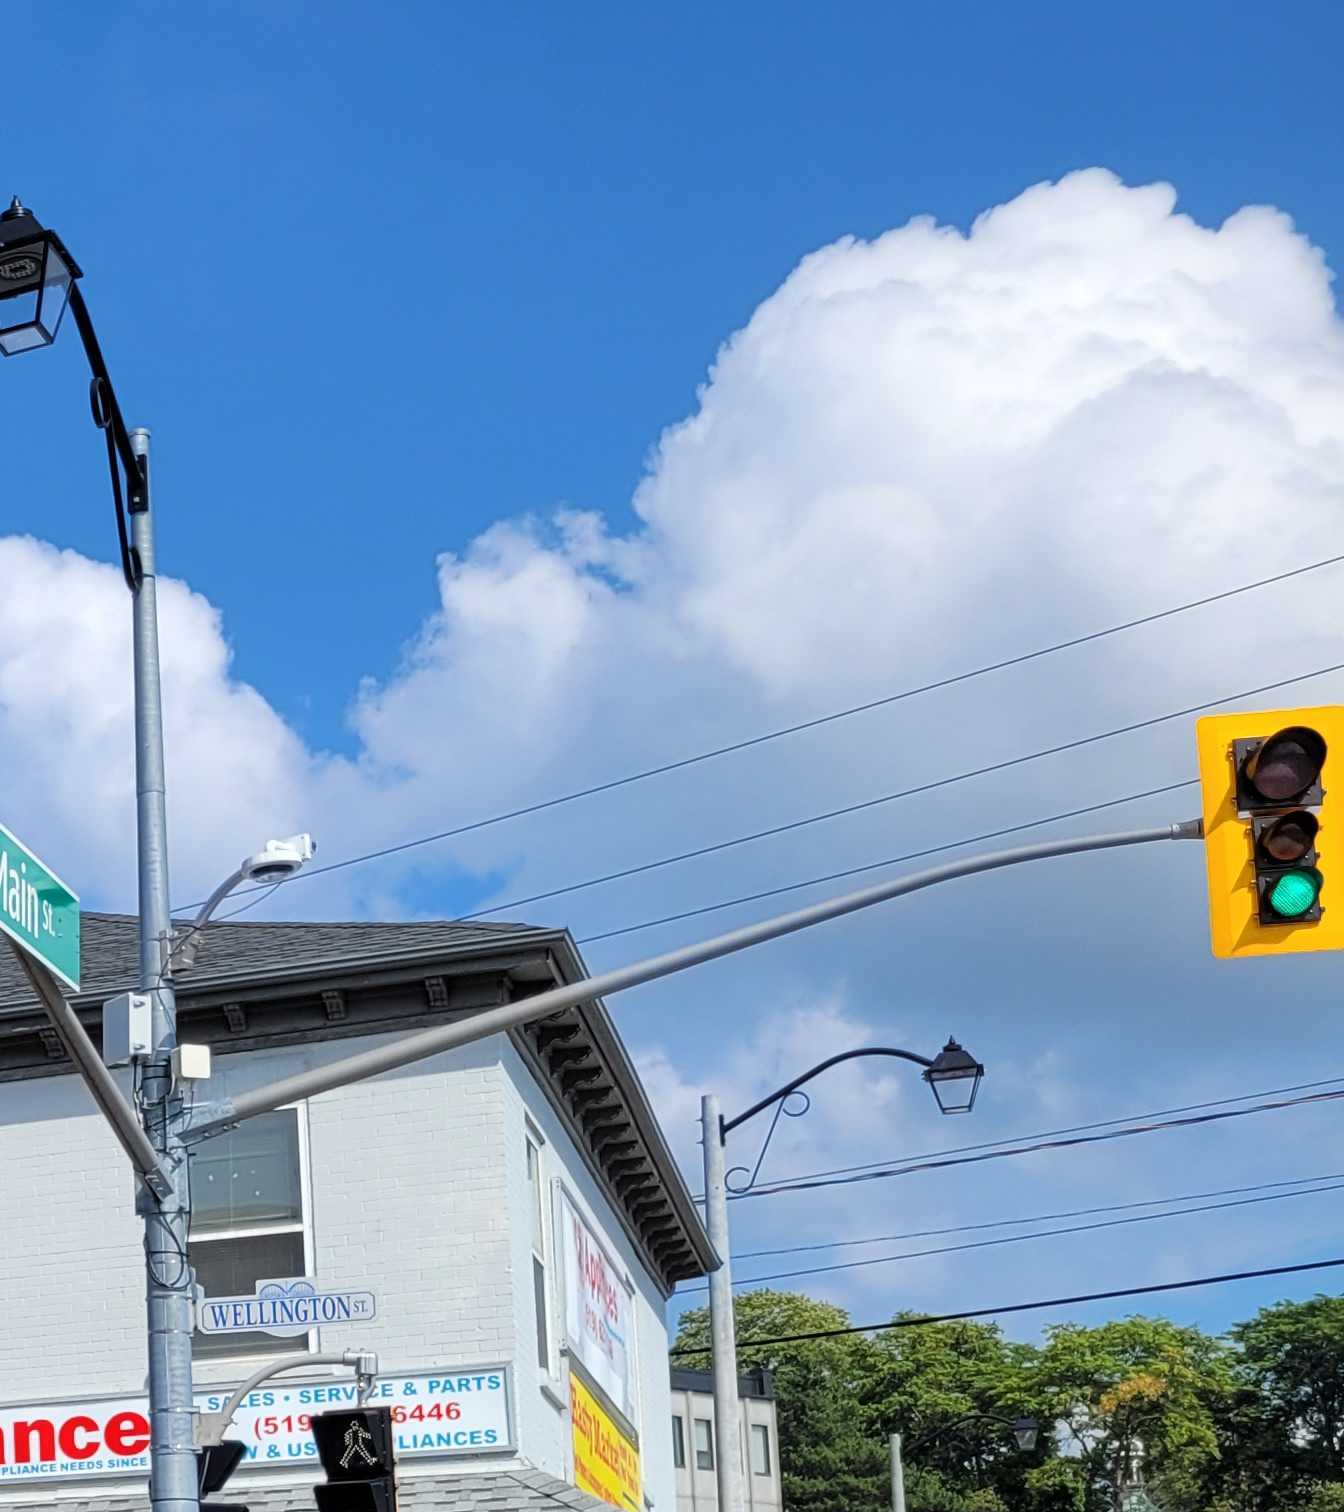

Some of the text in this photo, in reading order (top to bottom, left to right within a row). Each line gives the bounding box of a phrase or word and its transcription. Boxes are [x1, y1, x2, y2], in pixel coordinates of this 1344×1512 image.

[210, 1295, 369, 1328] WELLINGTON ST.
[299, 1379, 393, 1404] SERVE
[404, 1382, 417, 1396] &
[428, 1375, 501, 1393] PARTS
[254, 1402, 461, 1441] (519 6446
[266, 1444, 281, 1459] &
[288, 1442, 316, 1457] US
[398, 1430, 497, 1450] LIANCES
[60, 1459, 104, 1472] NEEDS
[107, 1457, 148, 1469] SINCE
